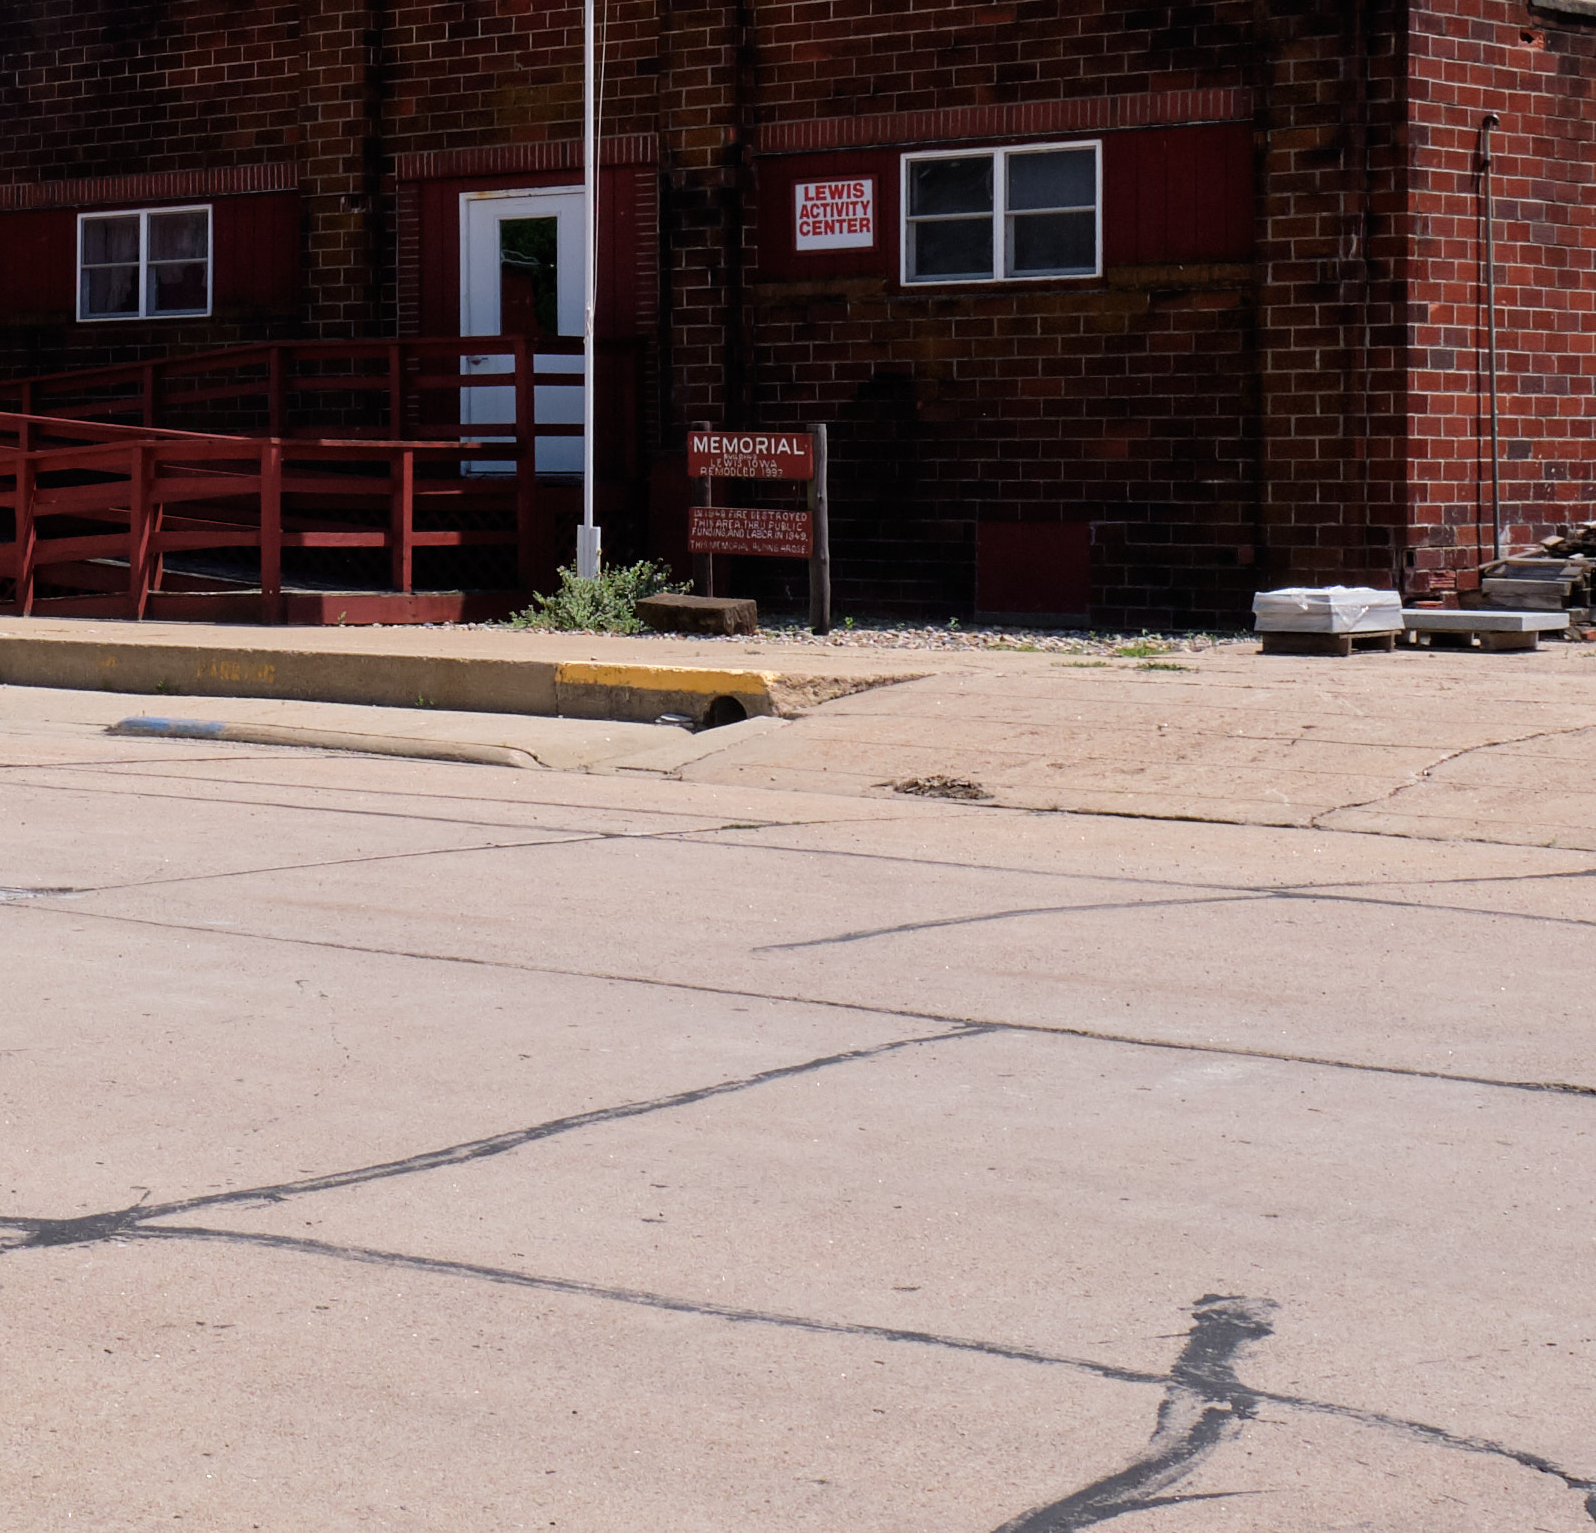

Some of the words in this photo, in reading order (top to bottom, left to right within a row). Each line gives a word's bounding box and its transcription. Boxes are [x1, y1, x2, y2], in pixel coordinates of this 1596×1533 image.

[803, 182, 865, 202] LEWIS
[799, 200, 870, 220] ACTIVITY
[799, 217, 871, 236] CENTER
[693, 436, 805, 455] MEMORIAL
[747, 459, 778, 468] IOWA
[728, 510, 748, 519] FIRE
[750, 511, 808, 522] DESTROYED
[694, 518, 714, 528] THIS
[768, 521, 803, 531] PUBLIC
[746, 529, 773, 539] LABOR
[774, 531, 784, 540] IN
